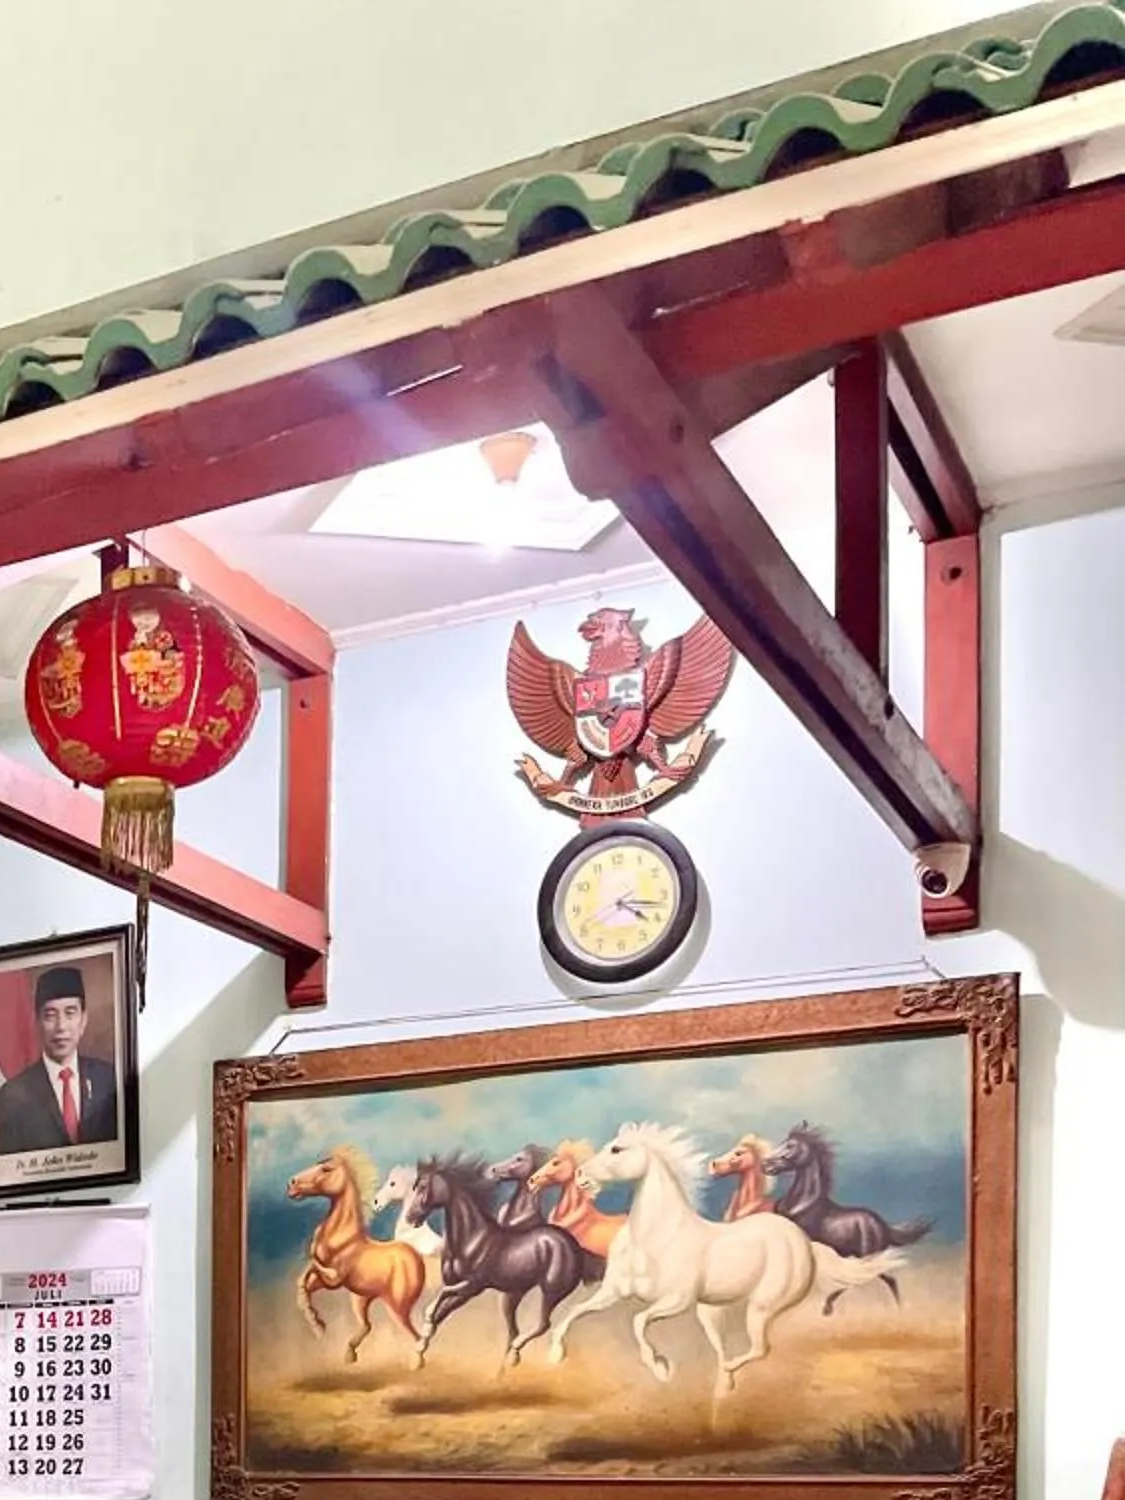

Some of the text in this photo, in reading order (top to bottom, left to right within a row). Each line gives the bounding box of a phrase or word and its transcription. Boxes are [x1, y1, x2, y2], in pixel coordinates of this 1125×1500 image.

[28, 1273, 68, 1289] 2024
[34, 1289, 63, 1301] JULI
[14, 1308, 112, 1329] 7 14 21 28
[14, 1337, 26, 1354] 8
[37, 1335, 57, 1353] 15
[63, 1334, 84, 1353] 22
[90, 1333, 112, 1351] 29
[14, 1361, 26, 1378] 9
[36, 1359, 57, 1377] 16
[62, 1359, 85, 1377] 23
[90, 1357, 112, 1376] 30
[9, 1385, 30, 1403] 10
[36, 1384, 57, 1403] 17
[63, 1383, 84, 1401] 24
[90, 1383, 111, 1401] 31
[9, 1410, 28, 1427] 11
[36, 1409, 57, 1427] 18
[62, 1408, 84, 1427] 25
[8, 1433, 29, 1452] 12
[36, 1433, 56, 1451] 19
[62, 1433, 84, 1451] 26
[8, 1458, 29, 1476] 13
[34, 1458, 57, 1475] 20
[62, 1457, 84, 1475] 27
